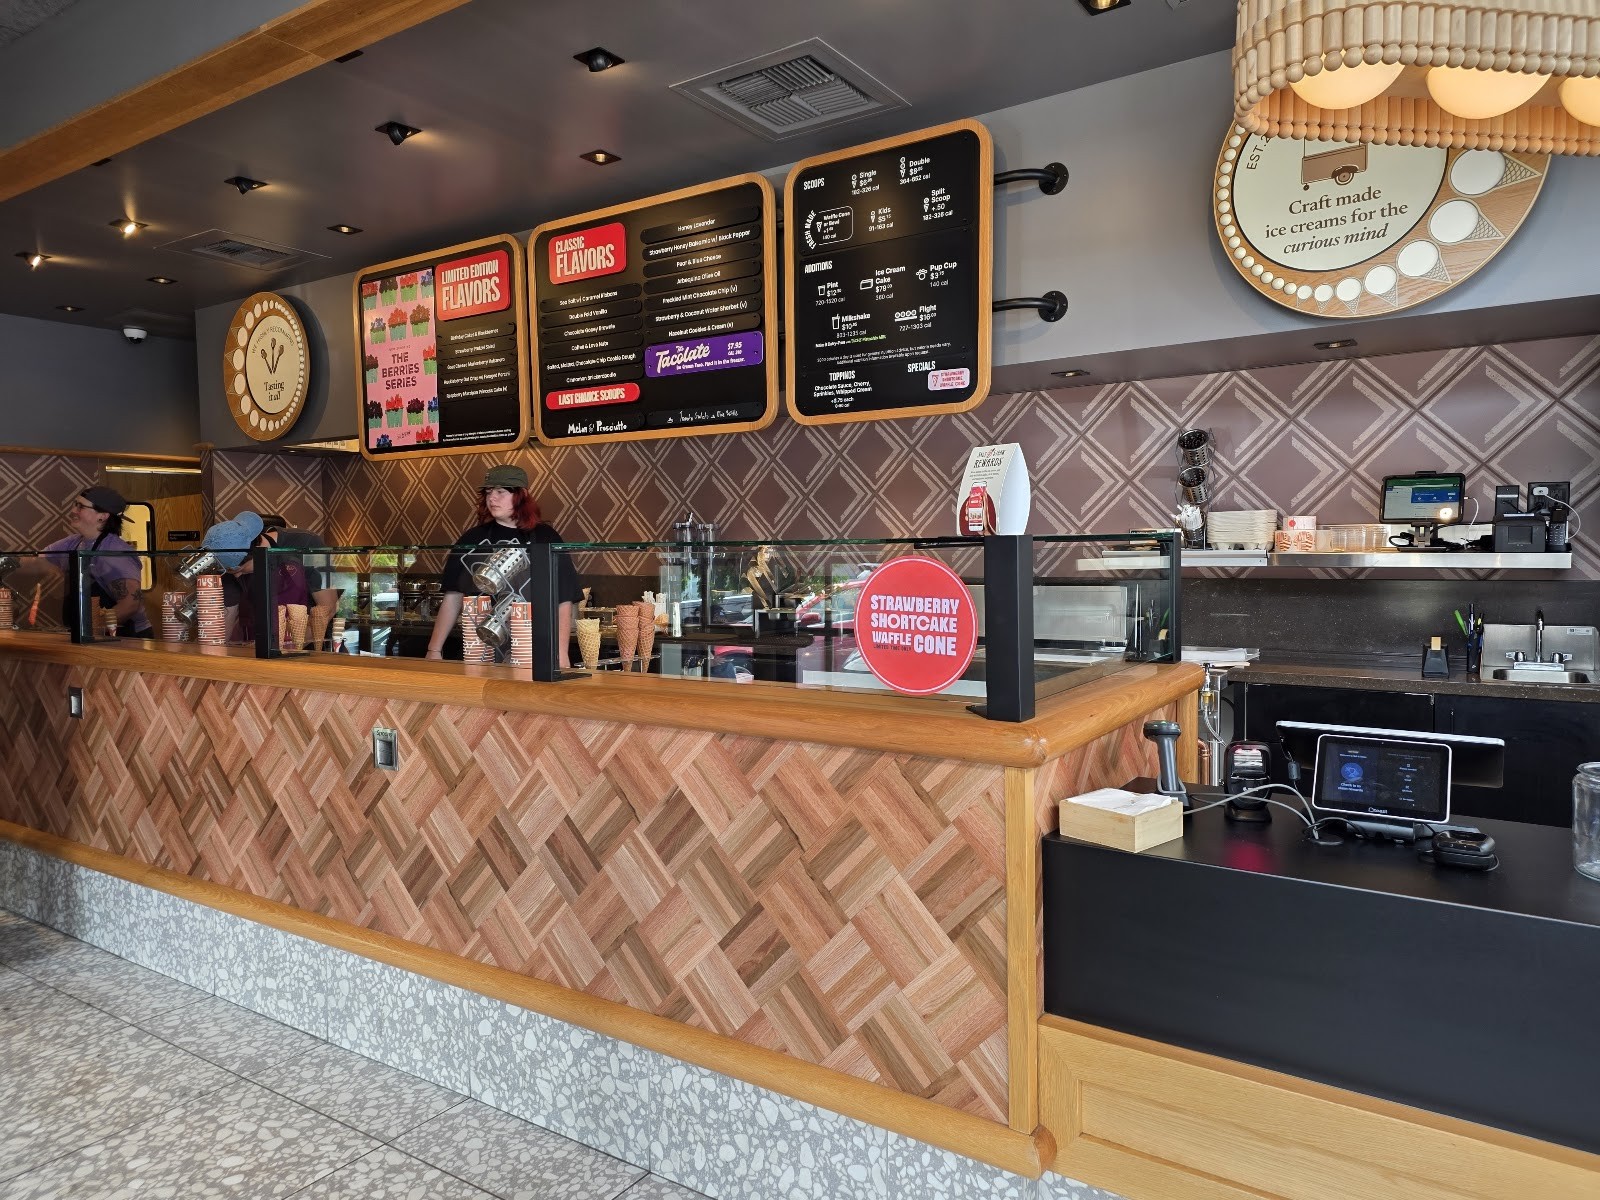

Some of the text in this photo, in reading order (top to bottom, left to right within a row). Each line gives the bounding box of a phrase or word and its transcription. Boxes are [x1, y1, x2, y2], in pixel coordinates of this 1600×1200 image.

[909, 157, 930, 167] Double
[859, 169, 877, 179] Single
[922, 172, 931, 180] cal
[803, 177, 825, 190] SCOOPS
[931, 187, 946, 197] Split
[931, 194, 951, 203] Scoop
[1289, 186, 1382, 215] Craft made
[878, 206, 892, 215] Kids
[945, 209, 954, 217] cal
[677, 218, 716, 232] Honey Lavender
[1265, 202, 1409, 239] ice creams for the
[804, 209, 817, 250] FRESH MADE
[555, 235, 585, 254] CLASSIC
[649, 246, 674, 256] Strawberry
[673, 242, 689, 251] Honey
[688, 238, 711, 248] Balsamic
[718, 233, 732, 242] Black
[732, 229, 751, 239] Pepper
[1283, 223, 1390, 255] curious mind
[556, 243, 615, 278] FLAVORS
[692, 257, 703, 265] Blue
[703, 254, 722, 262] Cheese
[441, 258, 499, 285] LIMITED EDITION
[804, 260, 833, 274] ADDITIONS
[875, 265, 906, 277] Ice Cream
[929, 261, 958, 272] Pup Cup
[713, 270, 721, 278] Oil
[875, 276, 891, 284] Cake
[826, 281, 839, 289] Pint
[940, 279, 949, 287] cal
[441, 275, 501, 312] FLAVORS
[559, 298, 568, 306] Sea
[567, 297, 577, 305] Salt
[582, 292, 601, 302] Caramel
[600, 290, 618, 299] Ribbons
[662, 295, 682, 304] Freckled
[692, 289, 718, 299] Chocolate
[717, 287, 730, 296] Chip
[583, 310, 593, 318] Fold
[592, 308, 608, 316] Vanilla
[655, 313, 680, 322] Strawberry
[684, 308, 705, 317] Coconut
[704, 305, 720, 314] Water
[719, 303, 739, 312] Sherbet
[739, 300, 748, 309] (v)
[919, 304, 937, 313] Flight
[841, 312, 871, 323] Milkshake
[563, 328, 585, 337] Chocolate
[598, 323, 616, 332] Brownie
[668, 329, 689, 337] Hazelnut
[688, 326, 707, 334] Cookies
[711, 323, 727, 331] Cream
[727, 341, 743, 351] $7.95
[391, 351, 409, 364] THE
[575, 359, 596, 367] Chocolate
[595, 356, 607, 364] Chip
[606, 354, 622, 362] Cookie
[621, 352, 637, 361] Dough
[655, 342, 711, 374] Tacolate
[381, 362, 420, 379] BERRIES
[907, 360, 936, 373] SPECIALS
[828, 370, 856, 381] TOPPINGS
[263, 380, 285, 392] Tasting
[385, 375, 417, 390] SERIES
[558, 387, 626, 406] LAST CHANCE SCOOPS
[836, 388, 856, 396] Whipped
[567, 422, 588, 434] Melon
[596, 420, 628, 432] Prosciutto
[973, 457, 1003, 468] REWARDS
[870, 594, 960, 615] STRAWBERRY
[870, 612, 958, 634] SHORTCAKE
[871, 630, 957, 657] WAFFLE CONE
